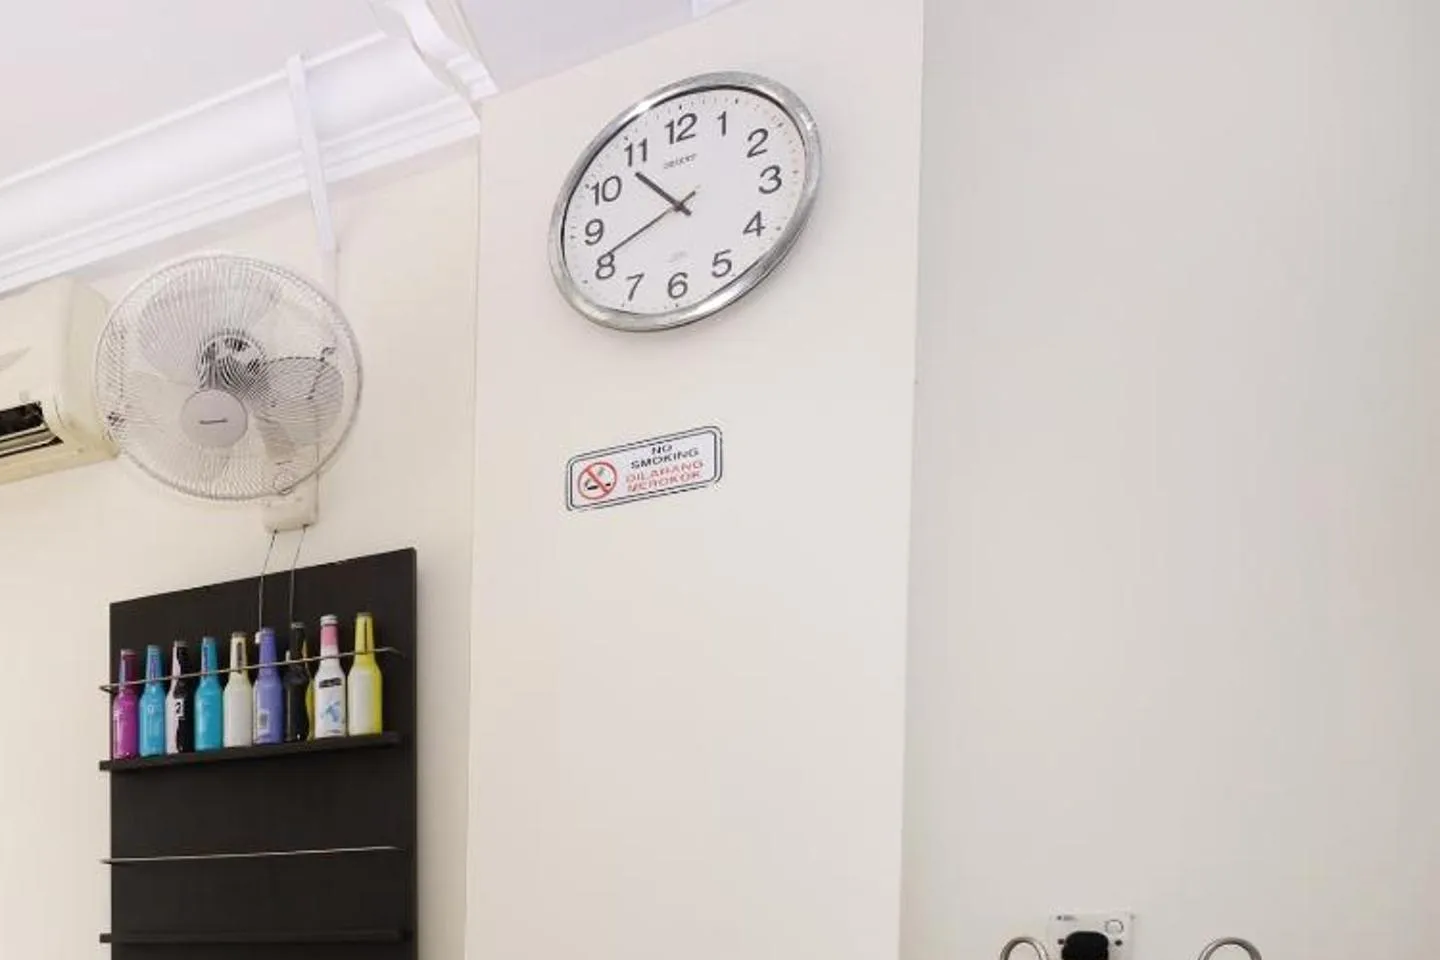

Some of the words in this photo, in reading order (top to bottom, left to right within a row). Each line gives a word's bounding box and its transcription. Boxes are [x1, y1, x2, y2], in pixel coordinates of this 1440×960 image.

[664, 113, 697, 144] 12
[716, 111, 728, 136] 1
[624, 139, 648, 166] 11
[746, 128, 769, 158] 2
[590, 176, 622, 205] 10
[759, 165, 782, 194] 3
[584, 218, 604, 246] 9
[743, 211, 765, 237] 4
[595, 252, 616, 280] 8
[712, 250, 733, 277] 5
[626, 273, 644, 301] 7
[667, 272, 688, 299] 6
[631, 448, 699, 469] SMOKING
[652, 445, 672, 455] NO
[626, 461, 703, 483] DILARANG
